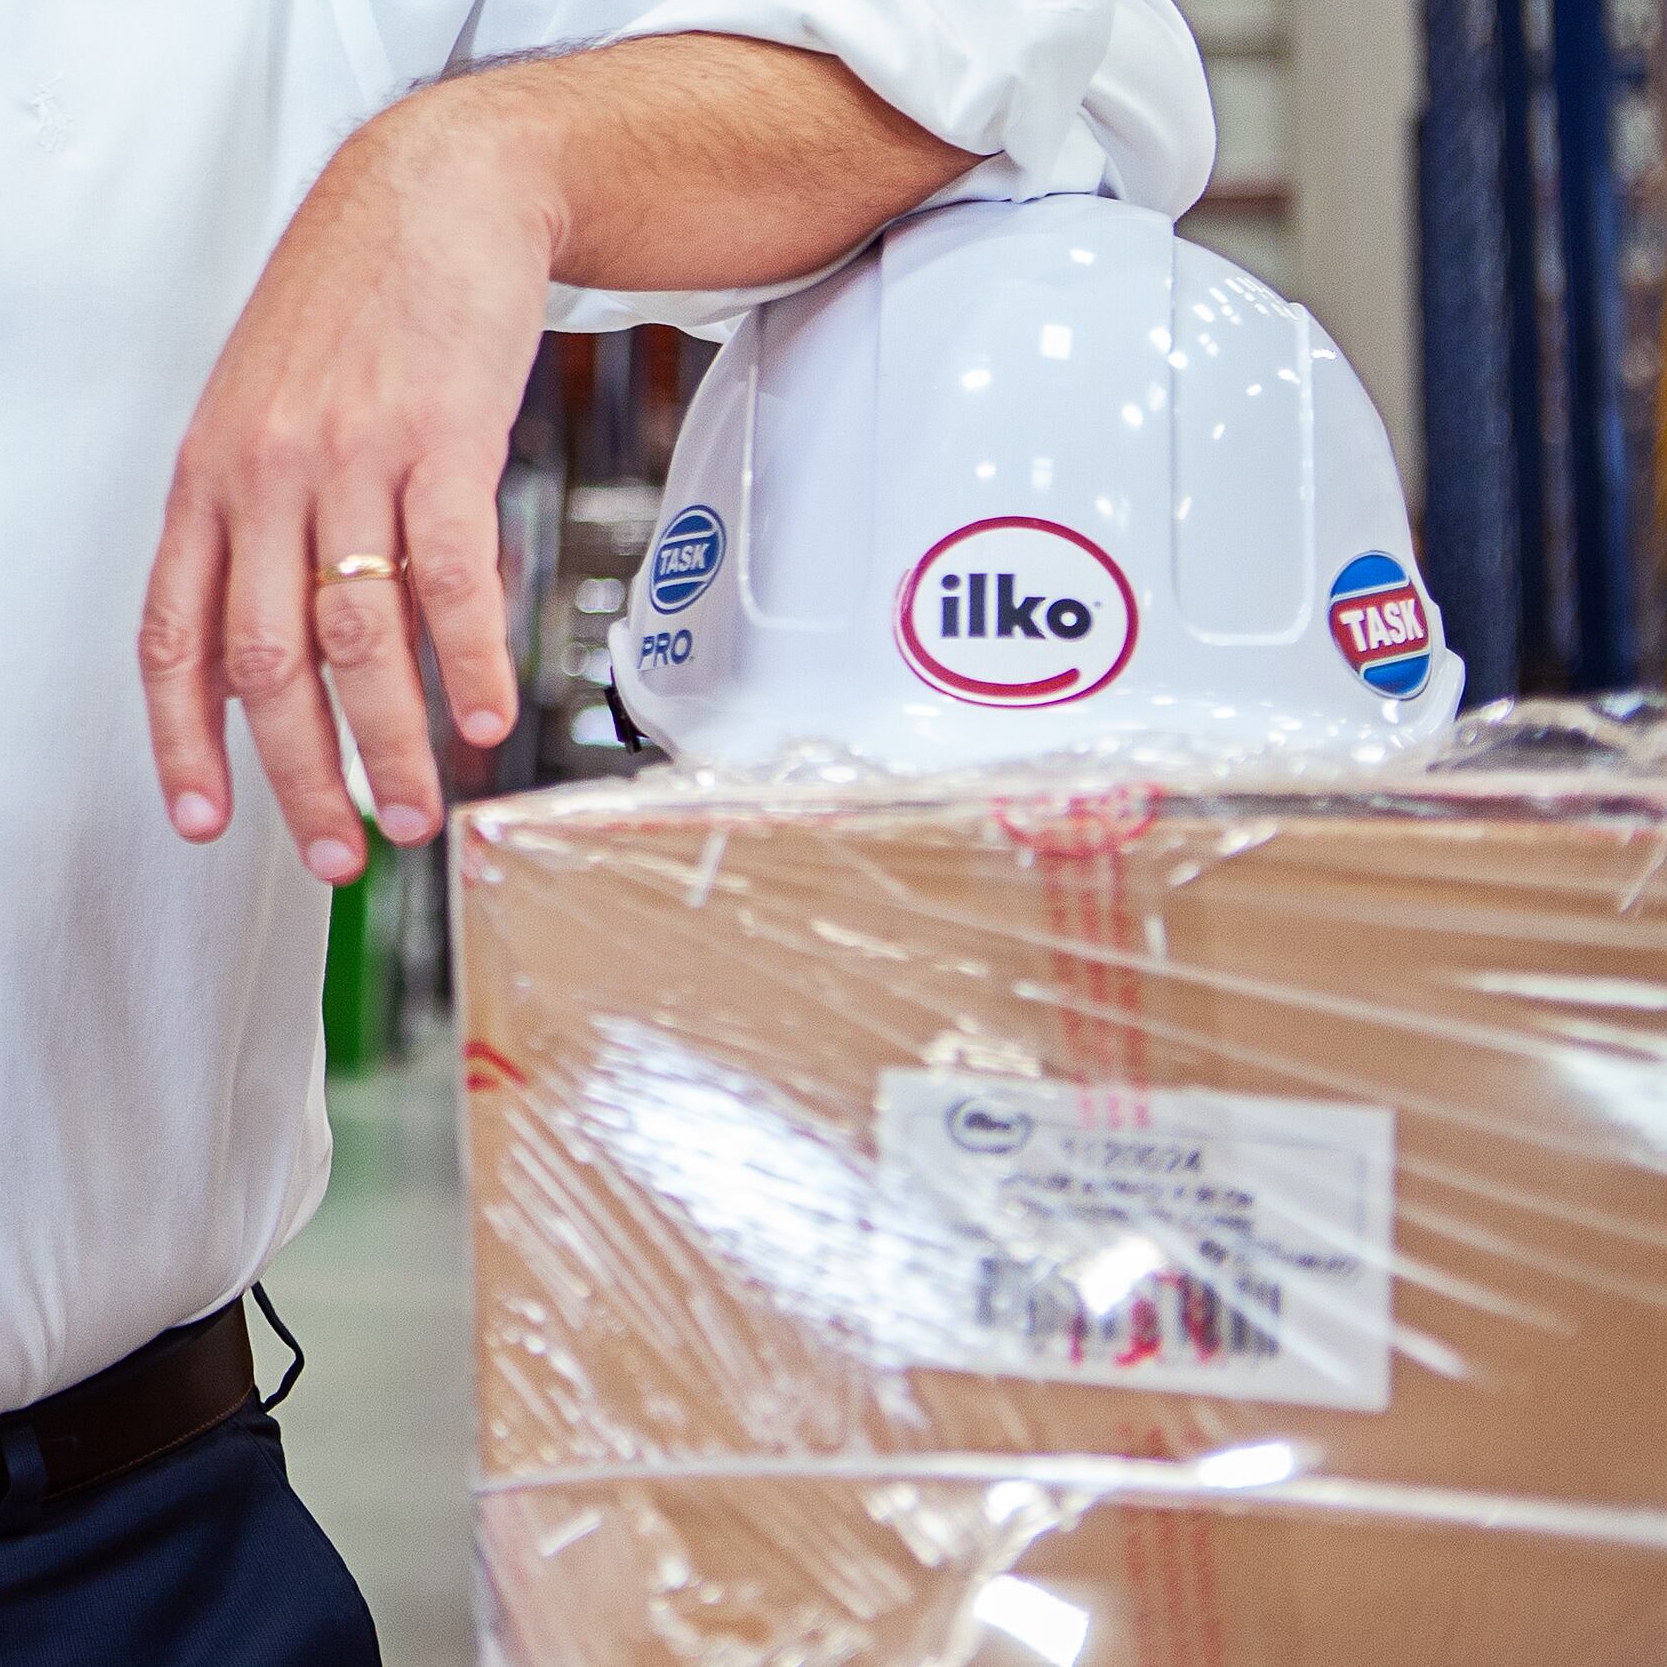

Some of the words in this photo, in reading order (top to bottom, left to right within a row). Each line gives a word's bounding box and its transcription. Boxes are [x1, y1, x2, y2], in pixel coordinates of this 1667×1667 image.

[660, 542, 710, 576] TASK
[940, 573, 1092, 640] ilko
[1339, 598, 1424, 652] TASK
[636, 629, 693, 669] PRO
